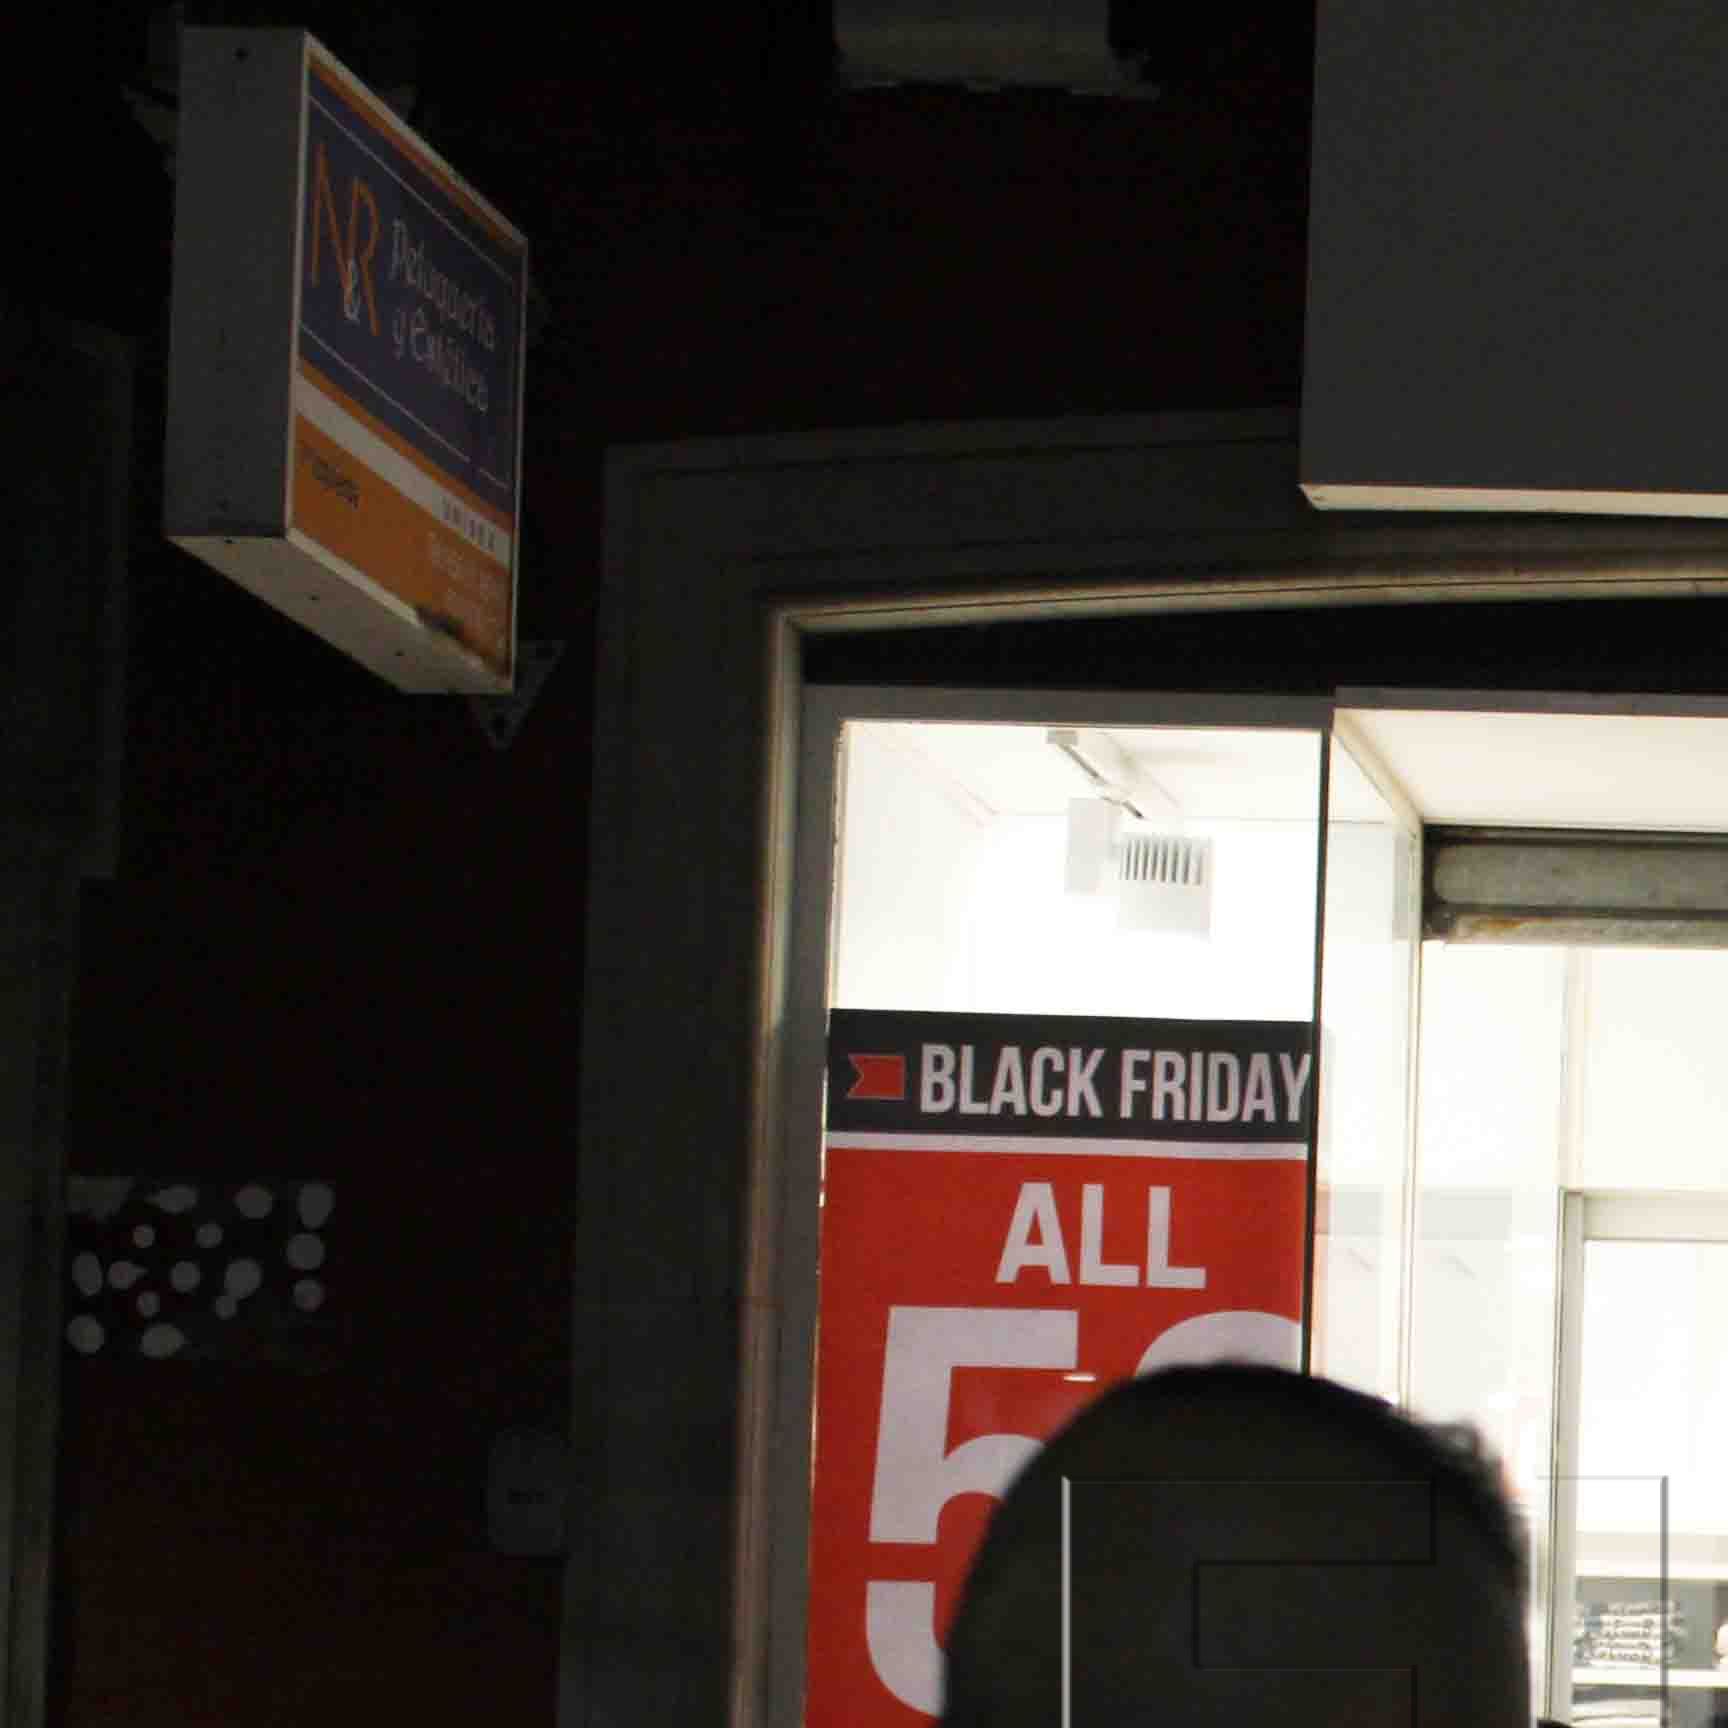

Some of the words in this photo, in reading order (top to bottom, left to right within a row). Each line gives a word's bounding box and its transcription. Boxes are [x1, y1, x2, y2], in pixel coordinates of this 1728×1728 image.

[920, 1042, 1104, 1118] BLACK
[1118, 1047, 1311, 1123] FRIDAY
[995, 1182, 1206, 1289] ALL
[866, 1304, 1302, 1718] 5
